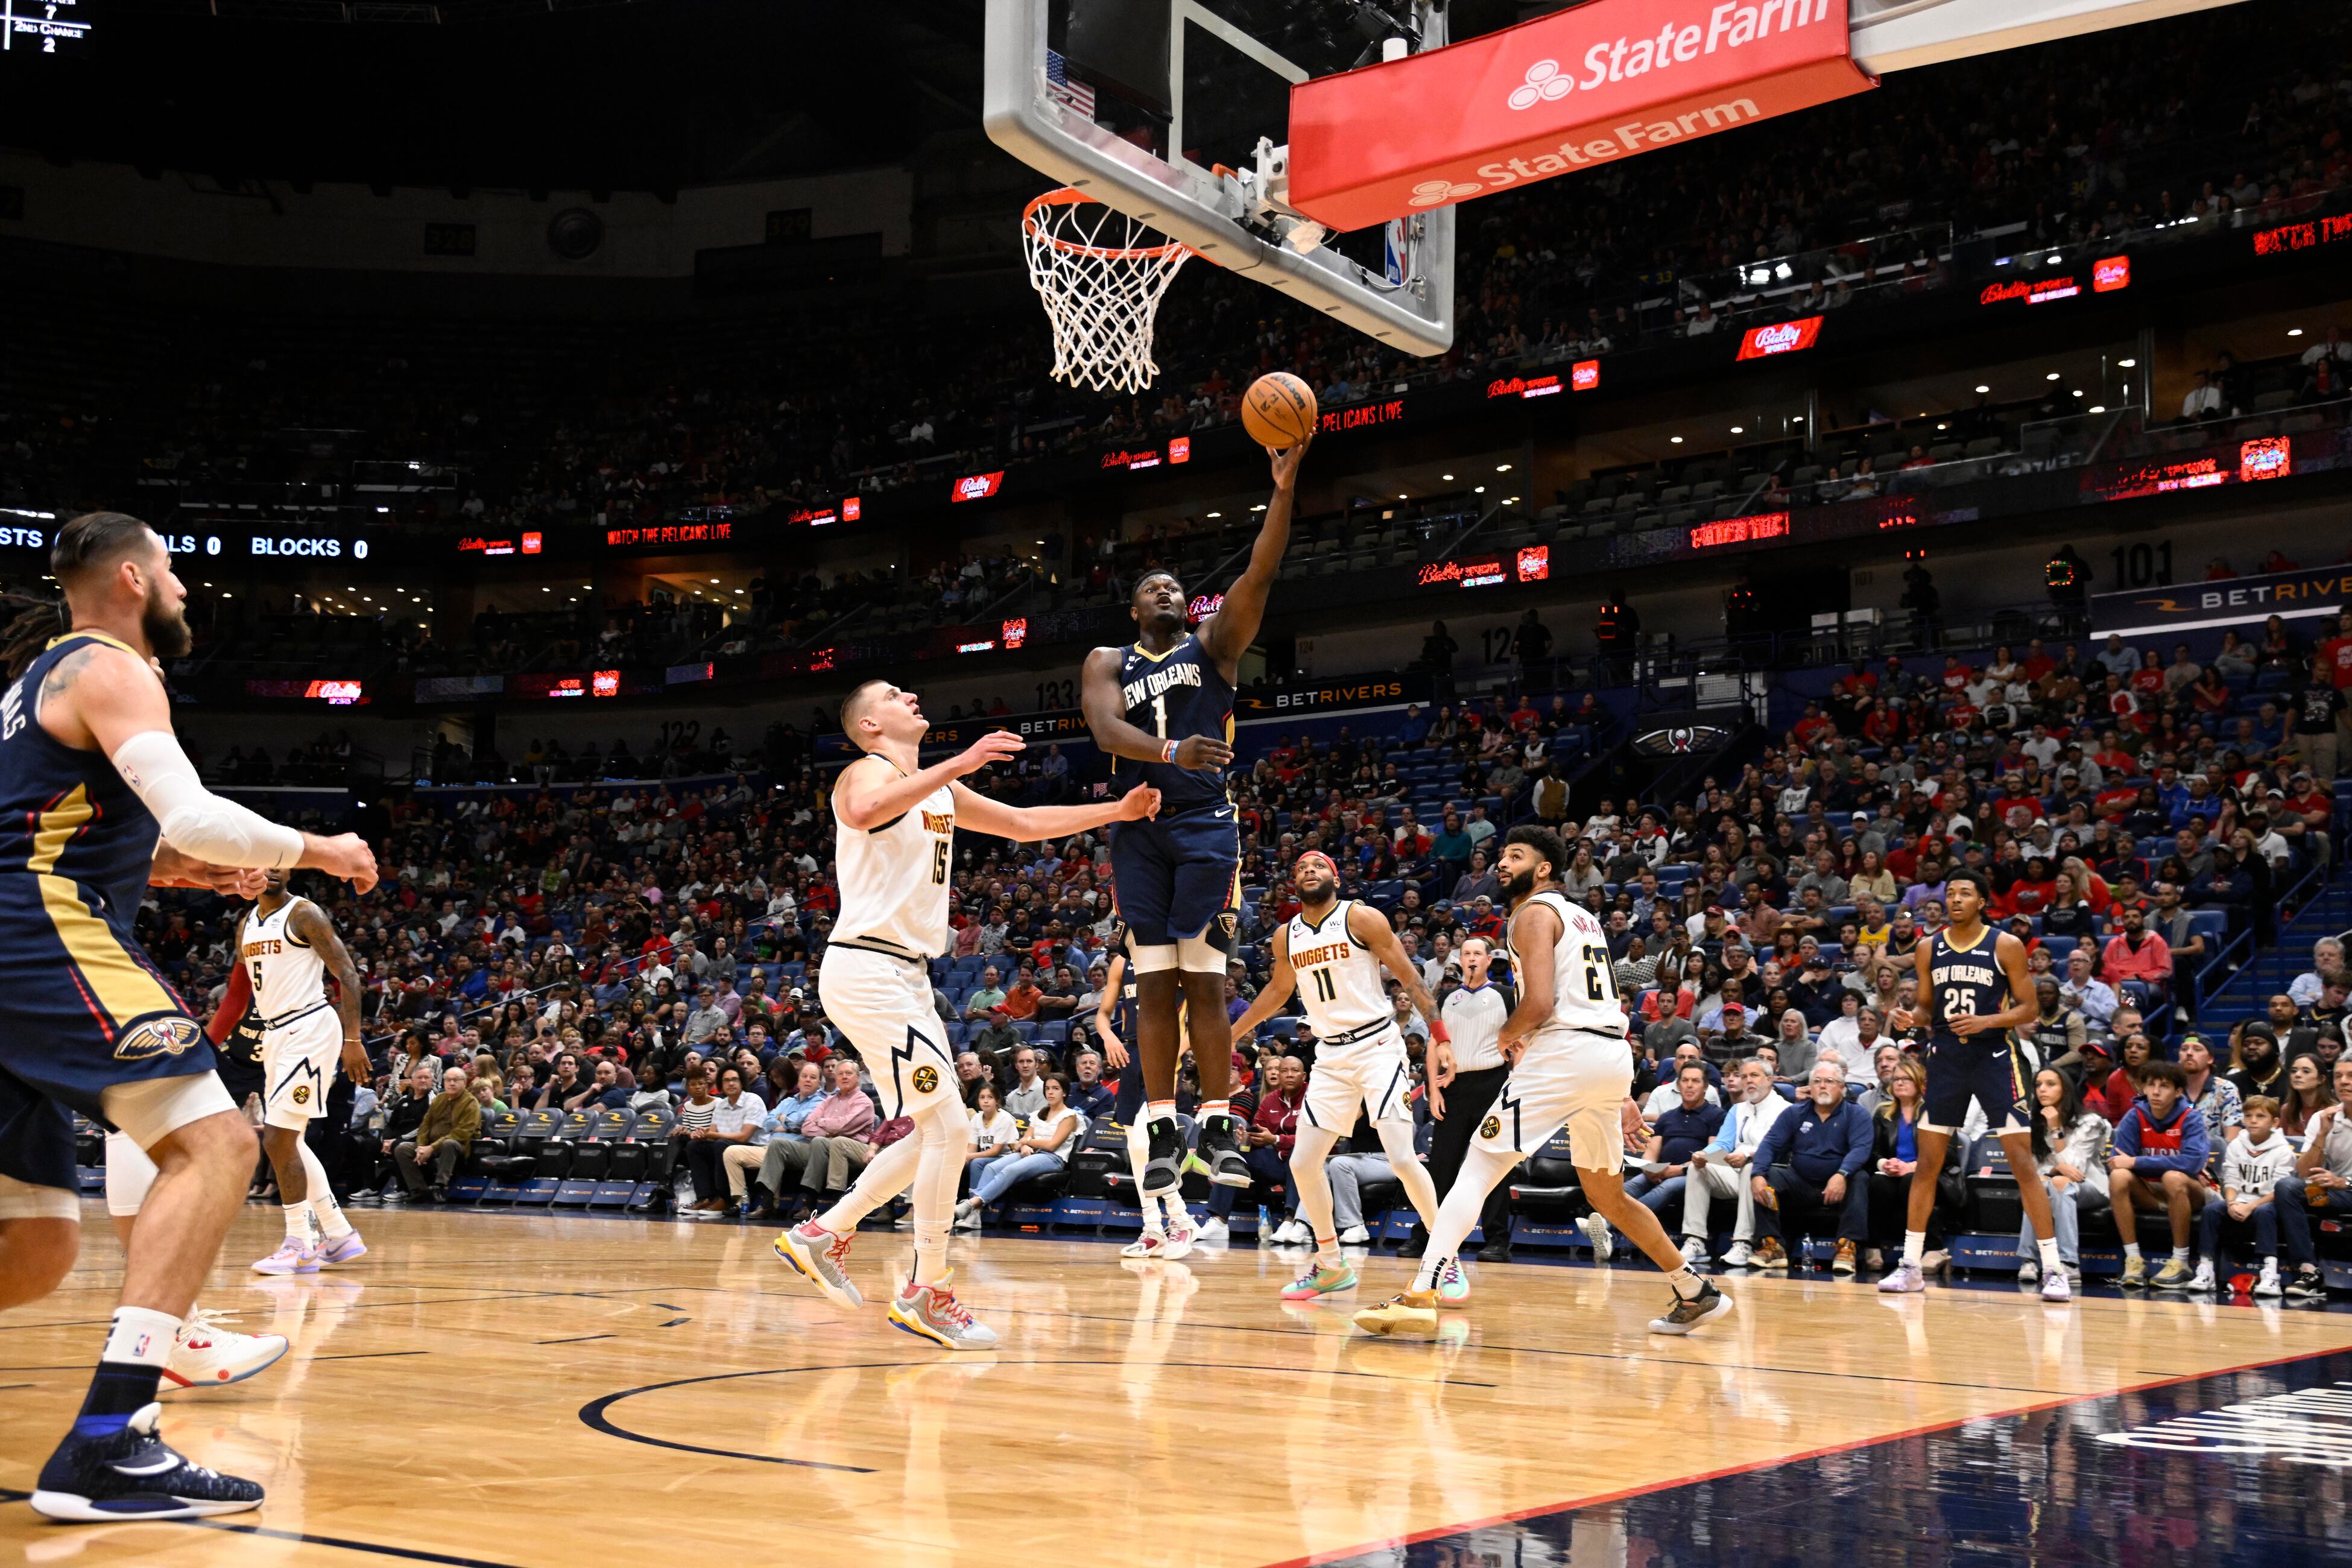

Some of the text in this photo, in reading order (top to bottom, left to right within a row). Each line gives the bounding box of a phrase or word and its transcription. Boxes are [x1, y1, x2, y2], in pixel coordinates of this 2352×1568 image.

[45, 5, 57, 19] 7
[43, 37, 55, 52] 2
[1755, 324, 1802, 348] Bally
[1323, 405, 1376, 432] PELICANS
[1379, 400, 1404, 422] LIVE
[960, 476, 991, 494] Bally
[207, 536, 221, 555] 0
[607, 523, 732, 546] WATCH THE PELICANS LIVE
[251, 537, 368, 559] BLOCKS 0
[1481, 627, 1511, 664] 12
[1146, 663, 1202, 696] ORLEANS
[1277, 683, 1402, 707] BETRIVERS
[1020, 717, 1088, 735] BETRIV
[1151, 695, 1168, 739] 1
[921, 810, 953, 834] NUGGET
[932, 840, 949, 885] 15
[1291, 942, 1350, 970] NUGGETS
[253, 961, 262, 991] 5
[1312, 967, 1336, 1002] 11
[1582, 944, 1620, 1001] 27
[1931, 965, 1994, 987] NEW ORLEANS
[1944, 988, 1976, 1020] 25
[2239, 1164, 2269, 1183] NOLA
